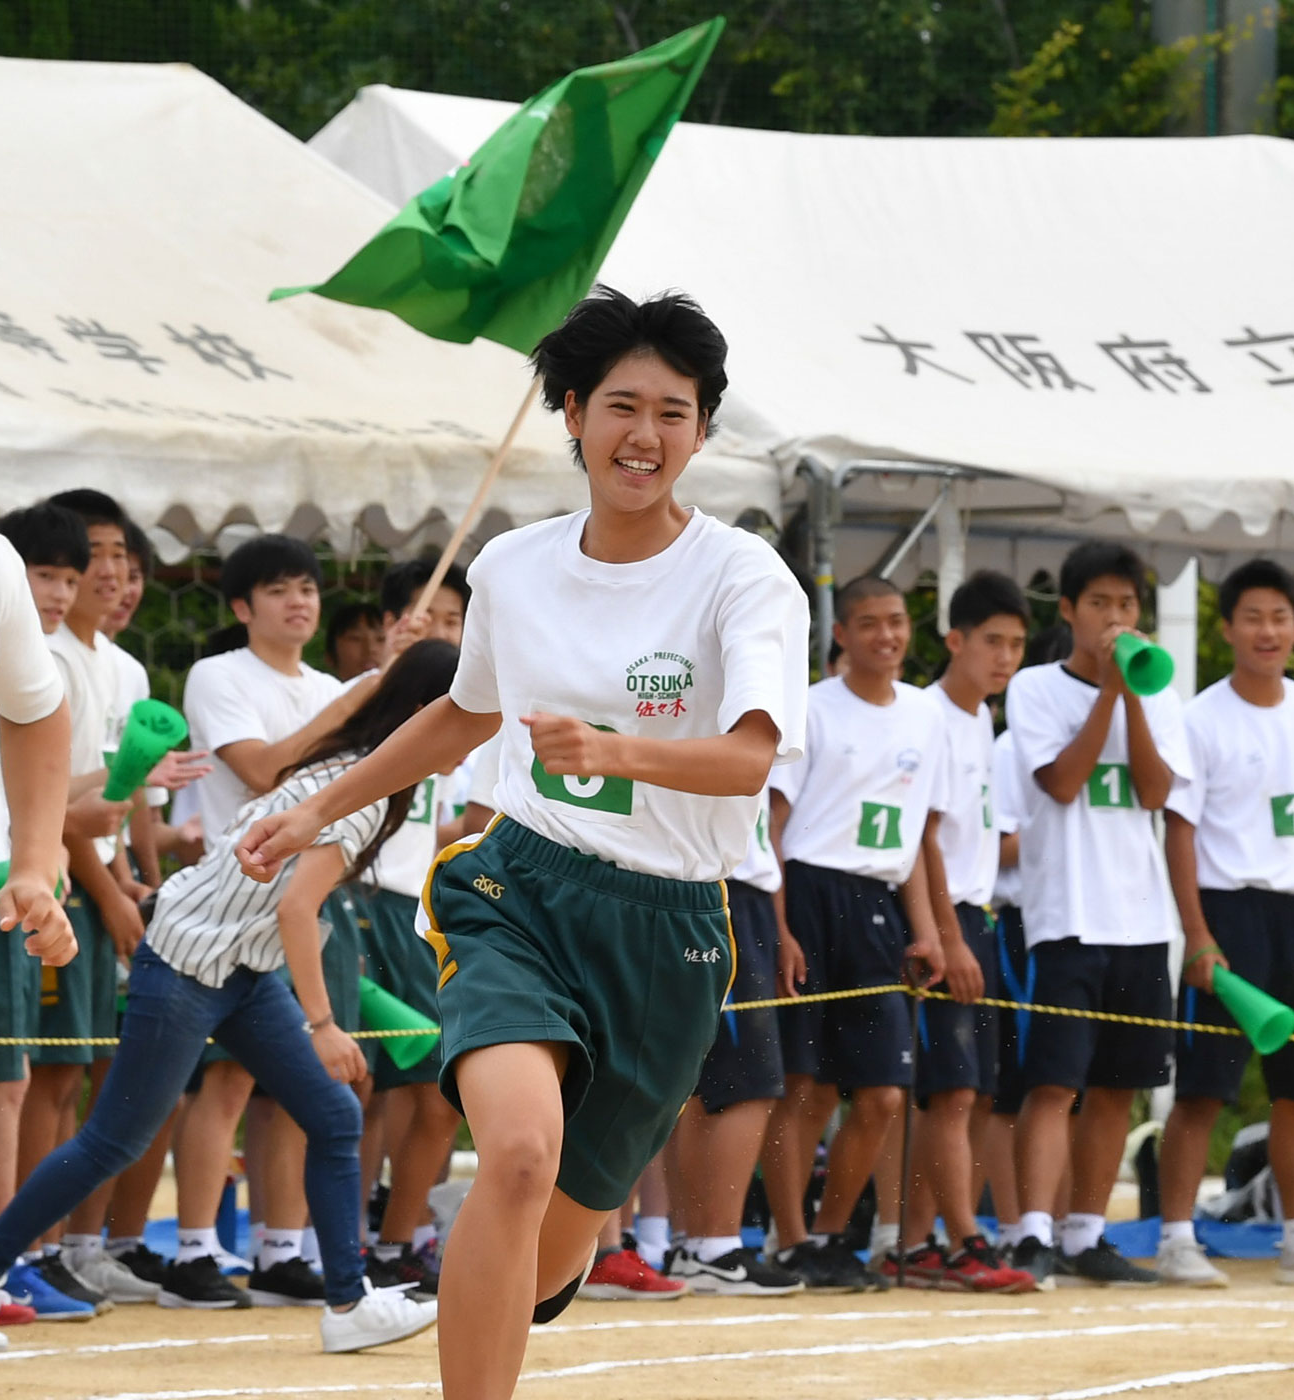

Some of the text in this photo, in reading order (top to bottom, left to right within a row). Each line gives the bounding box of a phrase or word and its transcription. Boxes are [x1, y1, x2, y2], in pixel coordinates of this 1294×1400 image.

[626, 672, 694, 692] OTSUKA
[635, 698, 686, 717] 佐々木
[1101, 766, 1122, 804] 1
[871, 807, 889, 846] 1
[473, 873, 505, 899] asics
